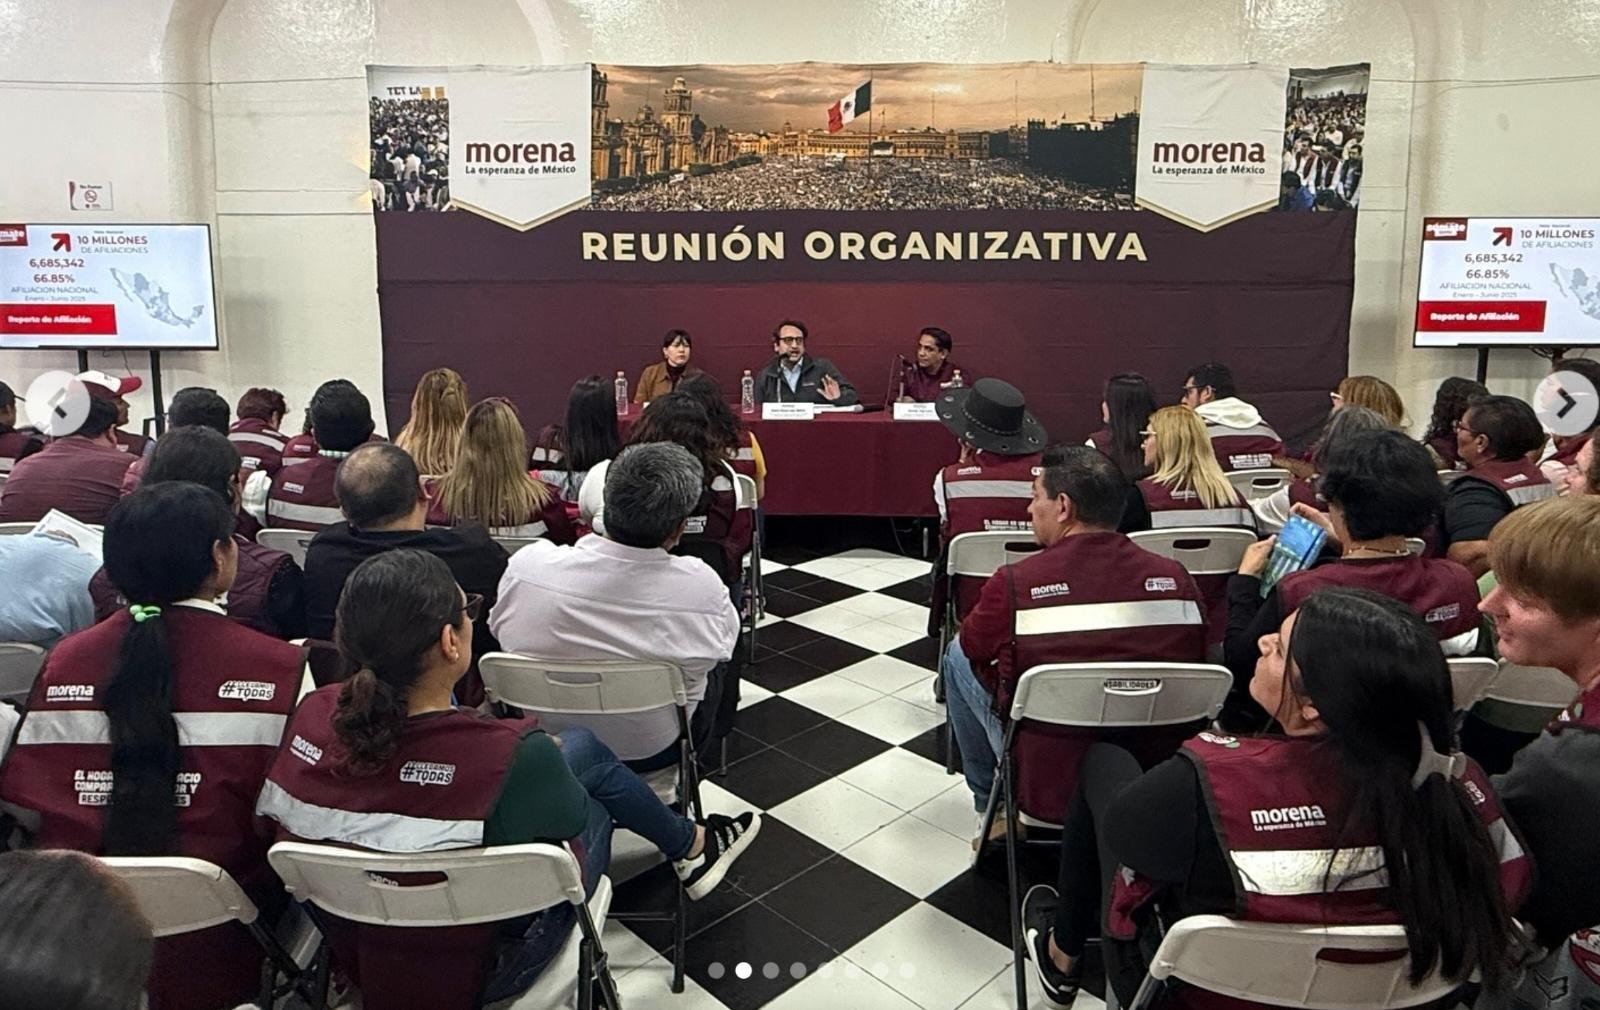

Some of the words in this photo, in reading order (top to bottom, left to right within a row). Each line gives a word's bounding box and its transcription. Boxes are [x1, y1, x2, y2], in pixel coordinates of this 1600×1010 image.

[466, 142, 576, 163] morena
[1153, 142, 1266, 163] morena
[465, 166, 476, 174] La
[479, 167, 526, 176] esperanza
[528, 166, 539, 174] de
[542, 165, 576, 174] México
[1152, 166, 1163, 174] La
[1165, 167, 1213, 176] esperanza
[1216, 166, 1228, 174] de
[1231, 165, 1266, 174] México
[1521, 230, 1532, 239] 10
[1535, 229, 1595, 239] MILLONES
[77, 236, 89, 245] 10
[92, 236, 149, 245] MILLONES
[582, 225, 785, 262] REUNIÓN
[804, 231, 1148, 262] ORGANIZATIVA
[1522, 241, 1533, 249] DE
[1536, 241, 1593, 249] AFILIACIONES
[94, 246, 149, 254] AFILIACIONES
[29, 258, 85, 269] 6,685,342
[1465, 253, 1523, 264] 6,685,342
[33, 273, 75, 283] 66.85%
[1466, 269, 1510, 279] 66.85%
[57, 286, 98, 294] NACIONAL
[1488, 282, 1532, 290] NACIONAL
[8, 315, 40, 324] Reporte
[41, 315, 52, 323] de
[53, 315, 92, 323] Afiliación
[1430, 313, 1465, 322] Reporte
[1466, 312, 1478, 321] de
[1479, 312, 1520, 321] Afiliación
[1031, 583, 1069, 596] morena
[47, 685, 94, 697] morena
[291, 735, 323, 761] morena
[75, 770, 85, 781] EL
[87, 770, 113, 781] HOGA
[1251, 805, 1325, 825] morena
